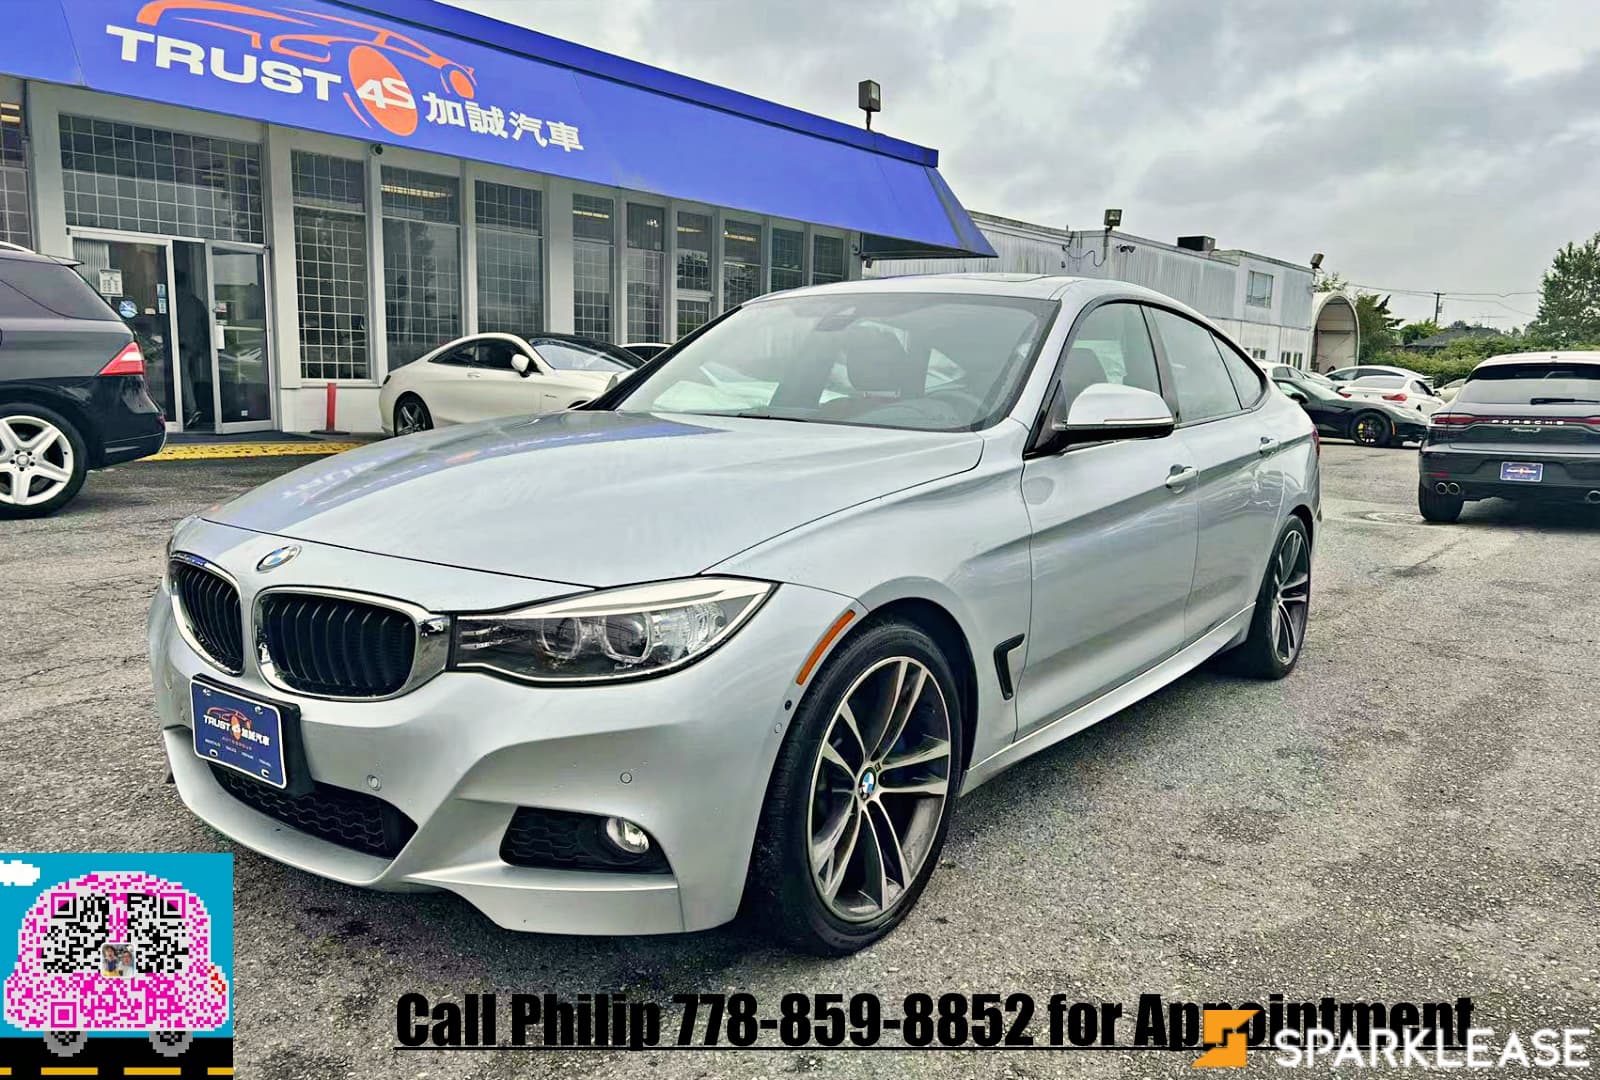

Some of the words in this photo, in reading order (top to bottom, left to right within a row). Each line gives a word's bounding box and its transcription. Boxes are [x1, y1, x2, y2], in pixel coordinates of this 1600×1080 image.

[106, 24, 342, 101] TRUST
[356, 77, 416, 110] 4S
[422, 91, 584, 153] 加誠汽車
[203, 714, 231, 732] TRUST
